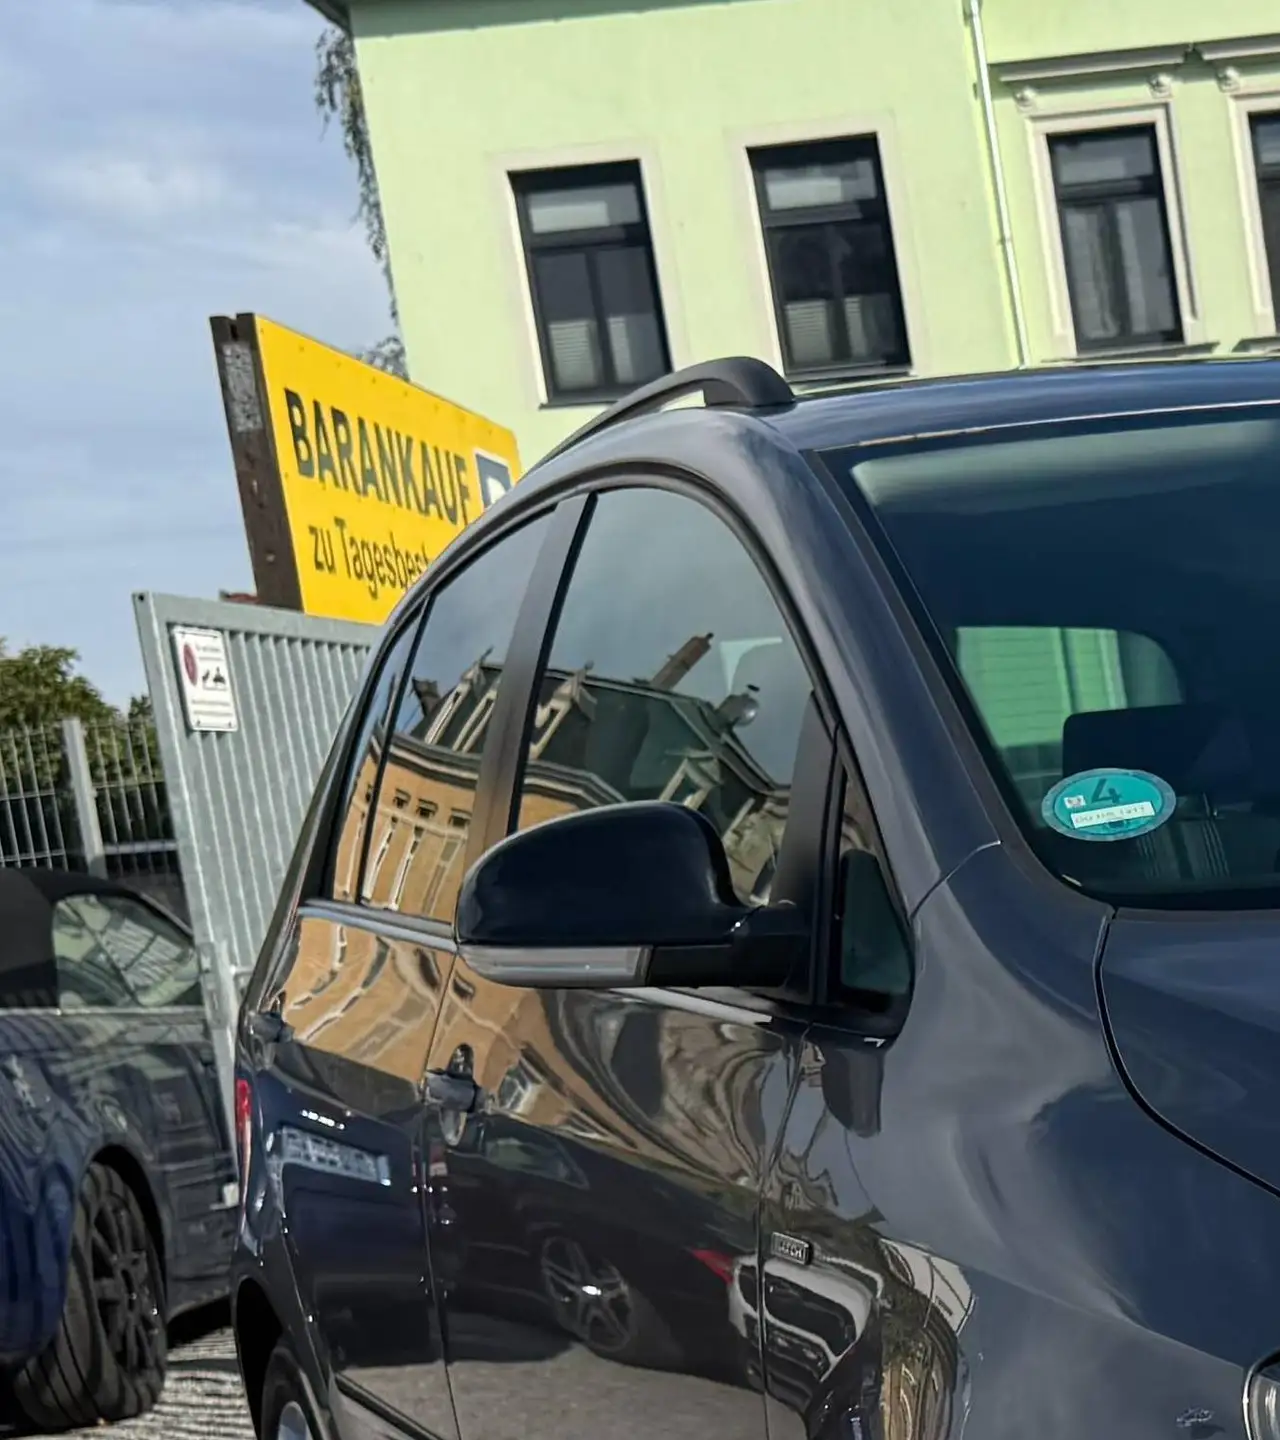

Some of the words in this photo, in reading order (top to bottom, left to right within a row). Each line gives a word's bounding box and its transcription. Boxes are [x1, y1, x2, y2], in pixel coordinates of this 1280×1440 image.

[284, 388, 471, 526] BARANKAUF
[308, 524, 337, 575] zu
[1091, 778, 1121, 804] 4
